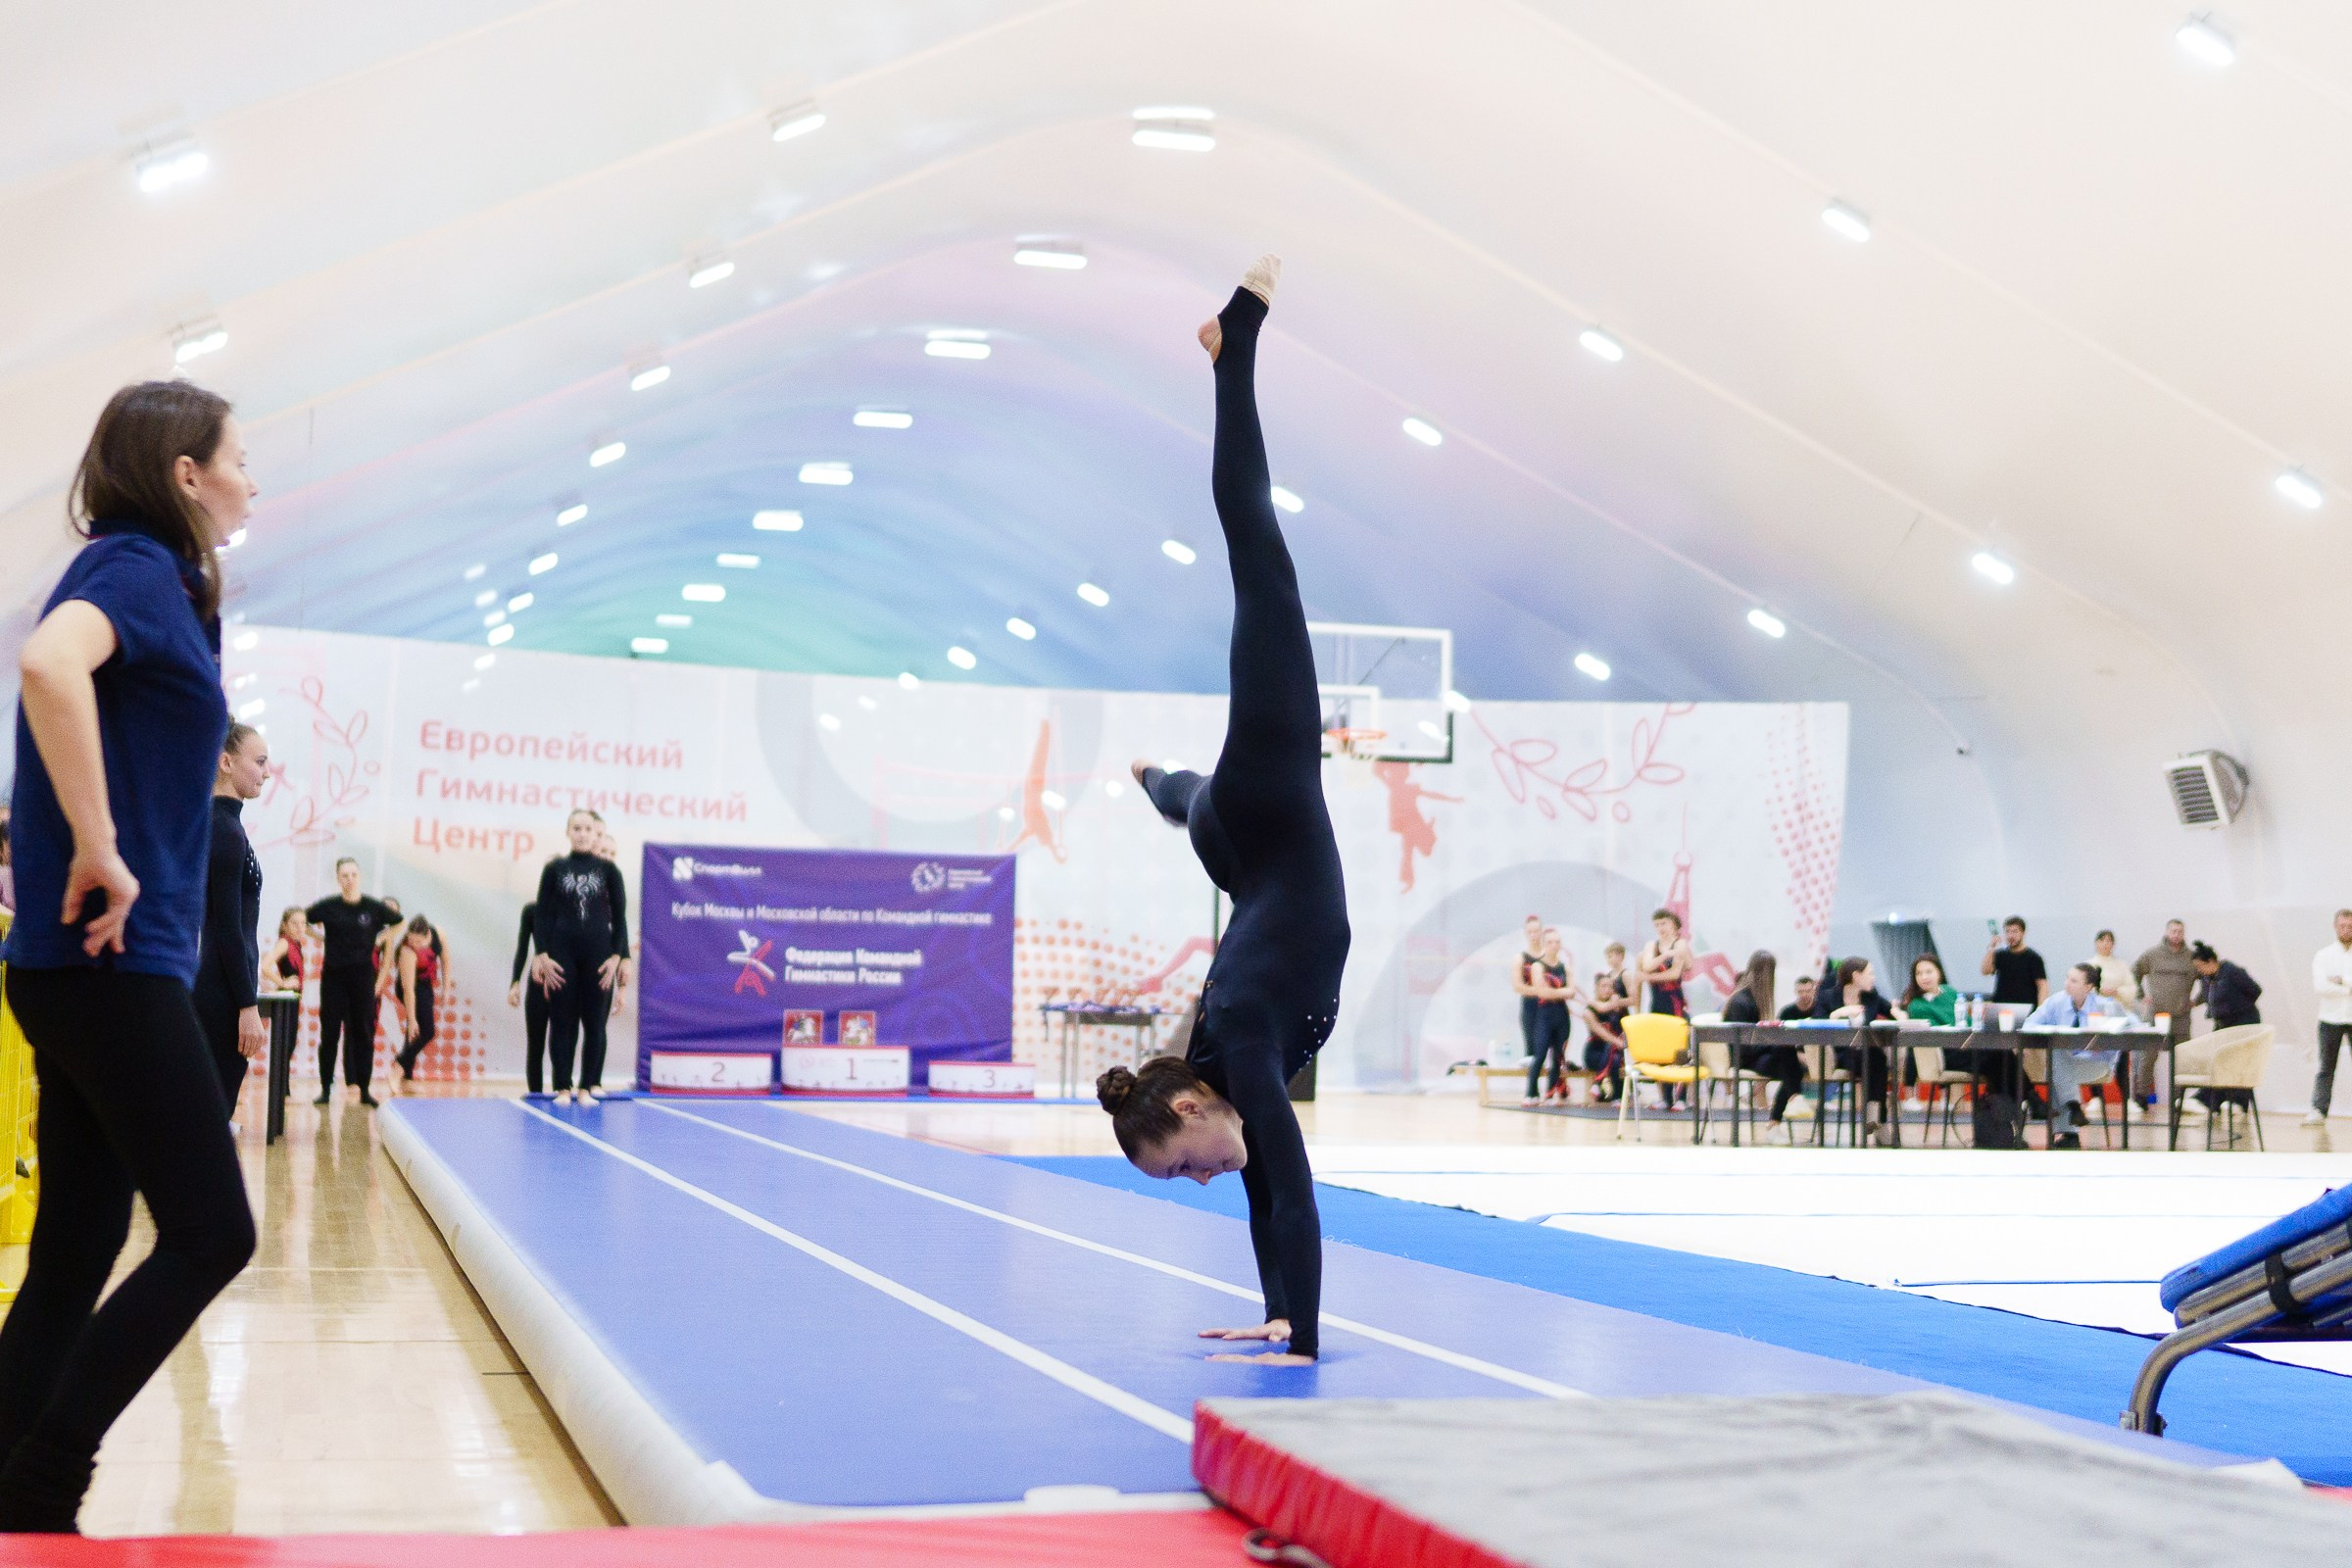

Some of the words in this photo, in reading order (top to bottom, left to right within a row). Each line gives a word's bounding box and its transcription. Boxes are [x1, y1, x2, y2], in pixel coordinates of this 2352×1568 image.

[418, 719, 683, 769] Европейский
[416, 767, 748, 822] Гимнастический
[413, 816, 535, 861] Центр
[671, 902, 702, 919] Кубок
[704, 903, 745, 918] Москвы
[746, 906, 754, 919] и
[756, 904, 817, 921] Московской
[818, 906, 859, 923] области
[875, 907, 932, 925] Командной
[785, 946, 854, 966] Федерация
[856, 948, 922, 967] Командной
[785, 965, 856, 984] Гимнастики
[858, 967, 902, 985] России
[711, 1061, 725, 1083] 2
[847, 1057, 858, 1081] 1
[983, 1069, 996, 1089] 3
